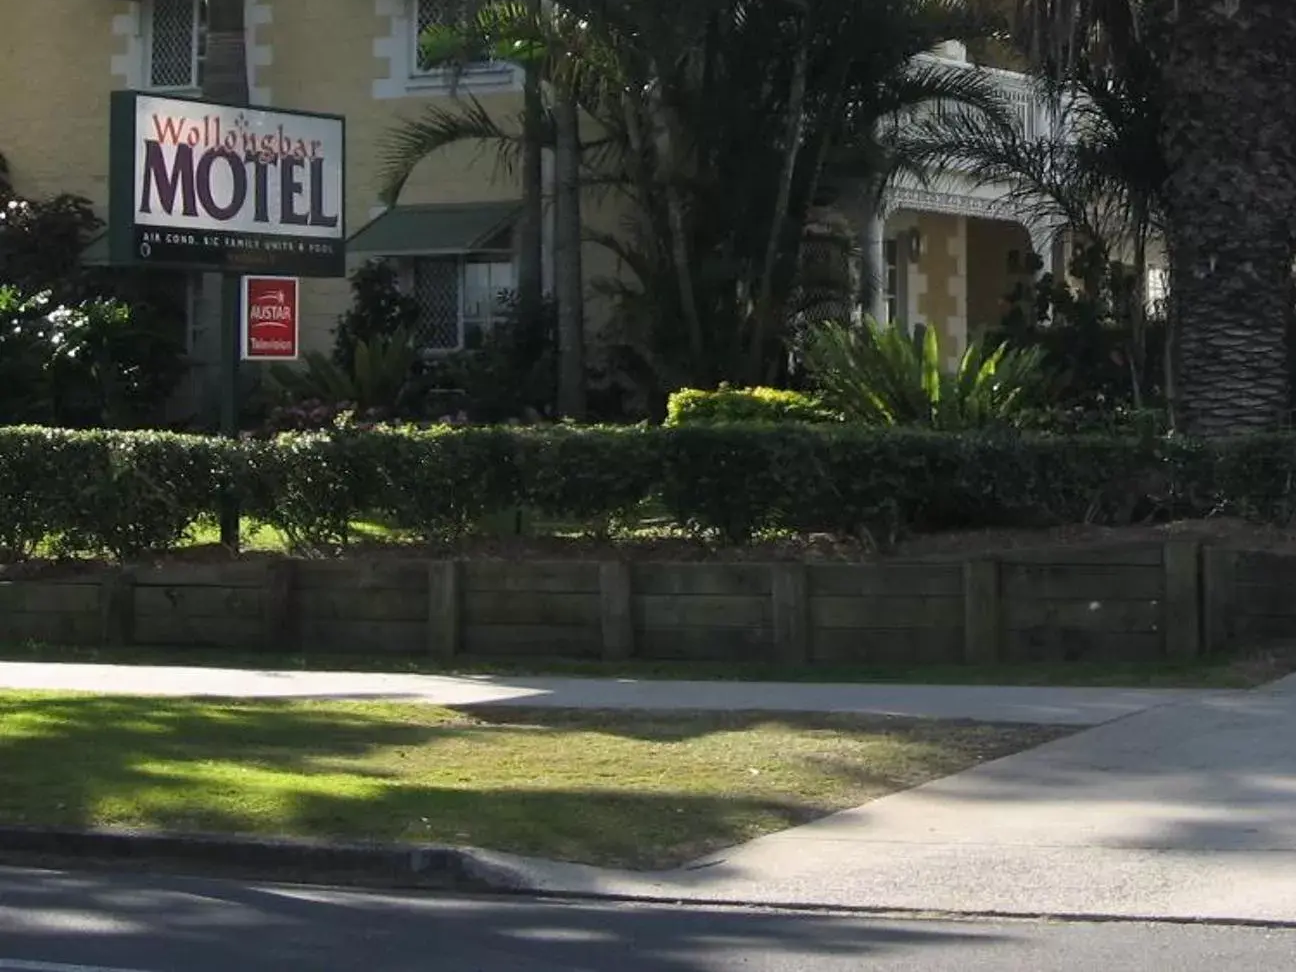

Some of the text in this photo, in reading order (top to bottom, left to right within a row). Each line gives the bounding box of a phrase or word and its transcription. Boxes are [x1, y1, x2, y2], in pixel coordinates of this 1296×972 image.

[152, 113, 323, 165] Wollongbar
[138, 138, 338, 228] MOTEL
[143, 231, 161, 242] AIR
[250, 303, 291, 321] AUSTAR
